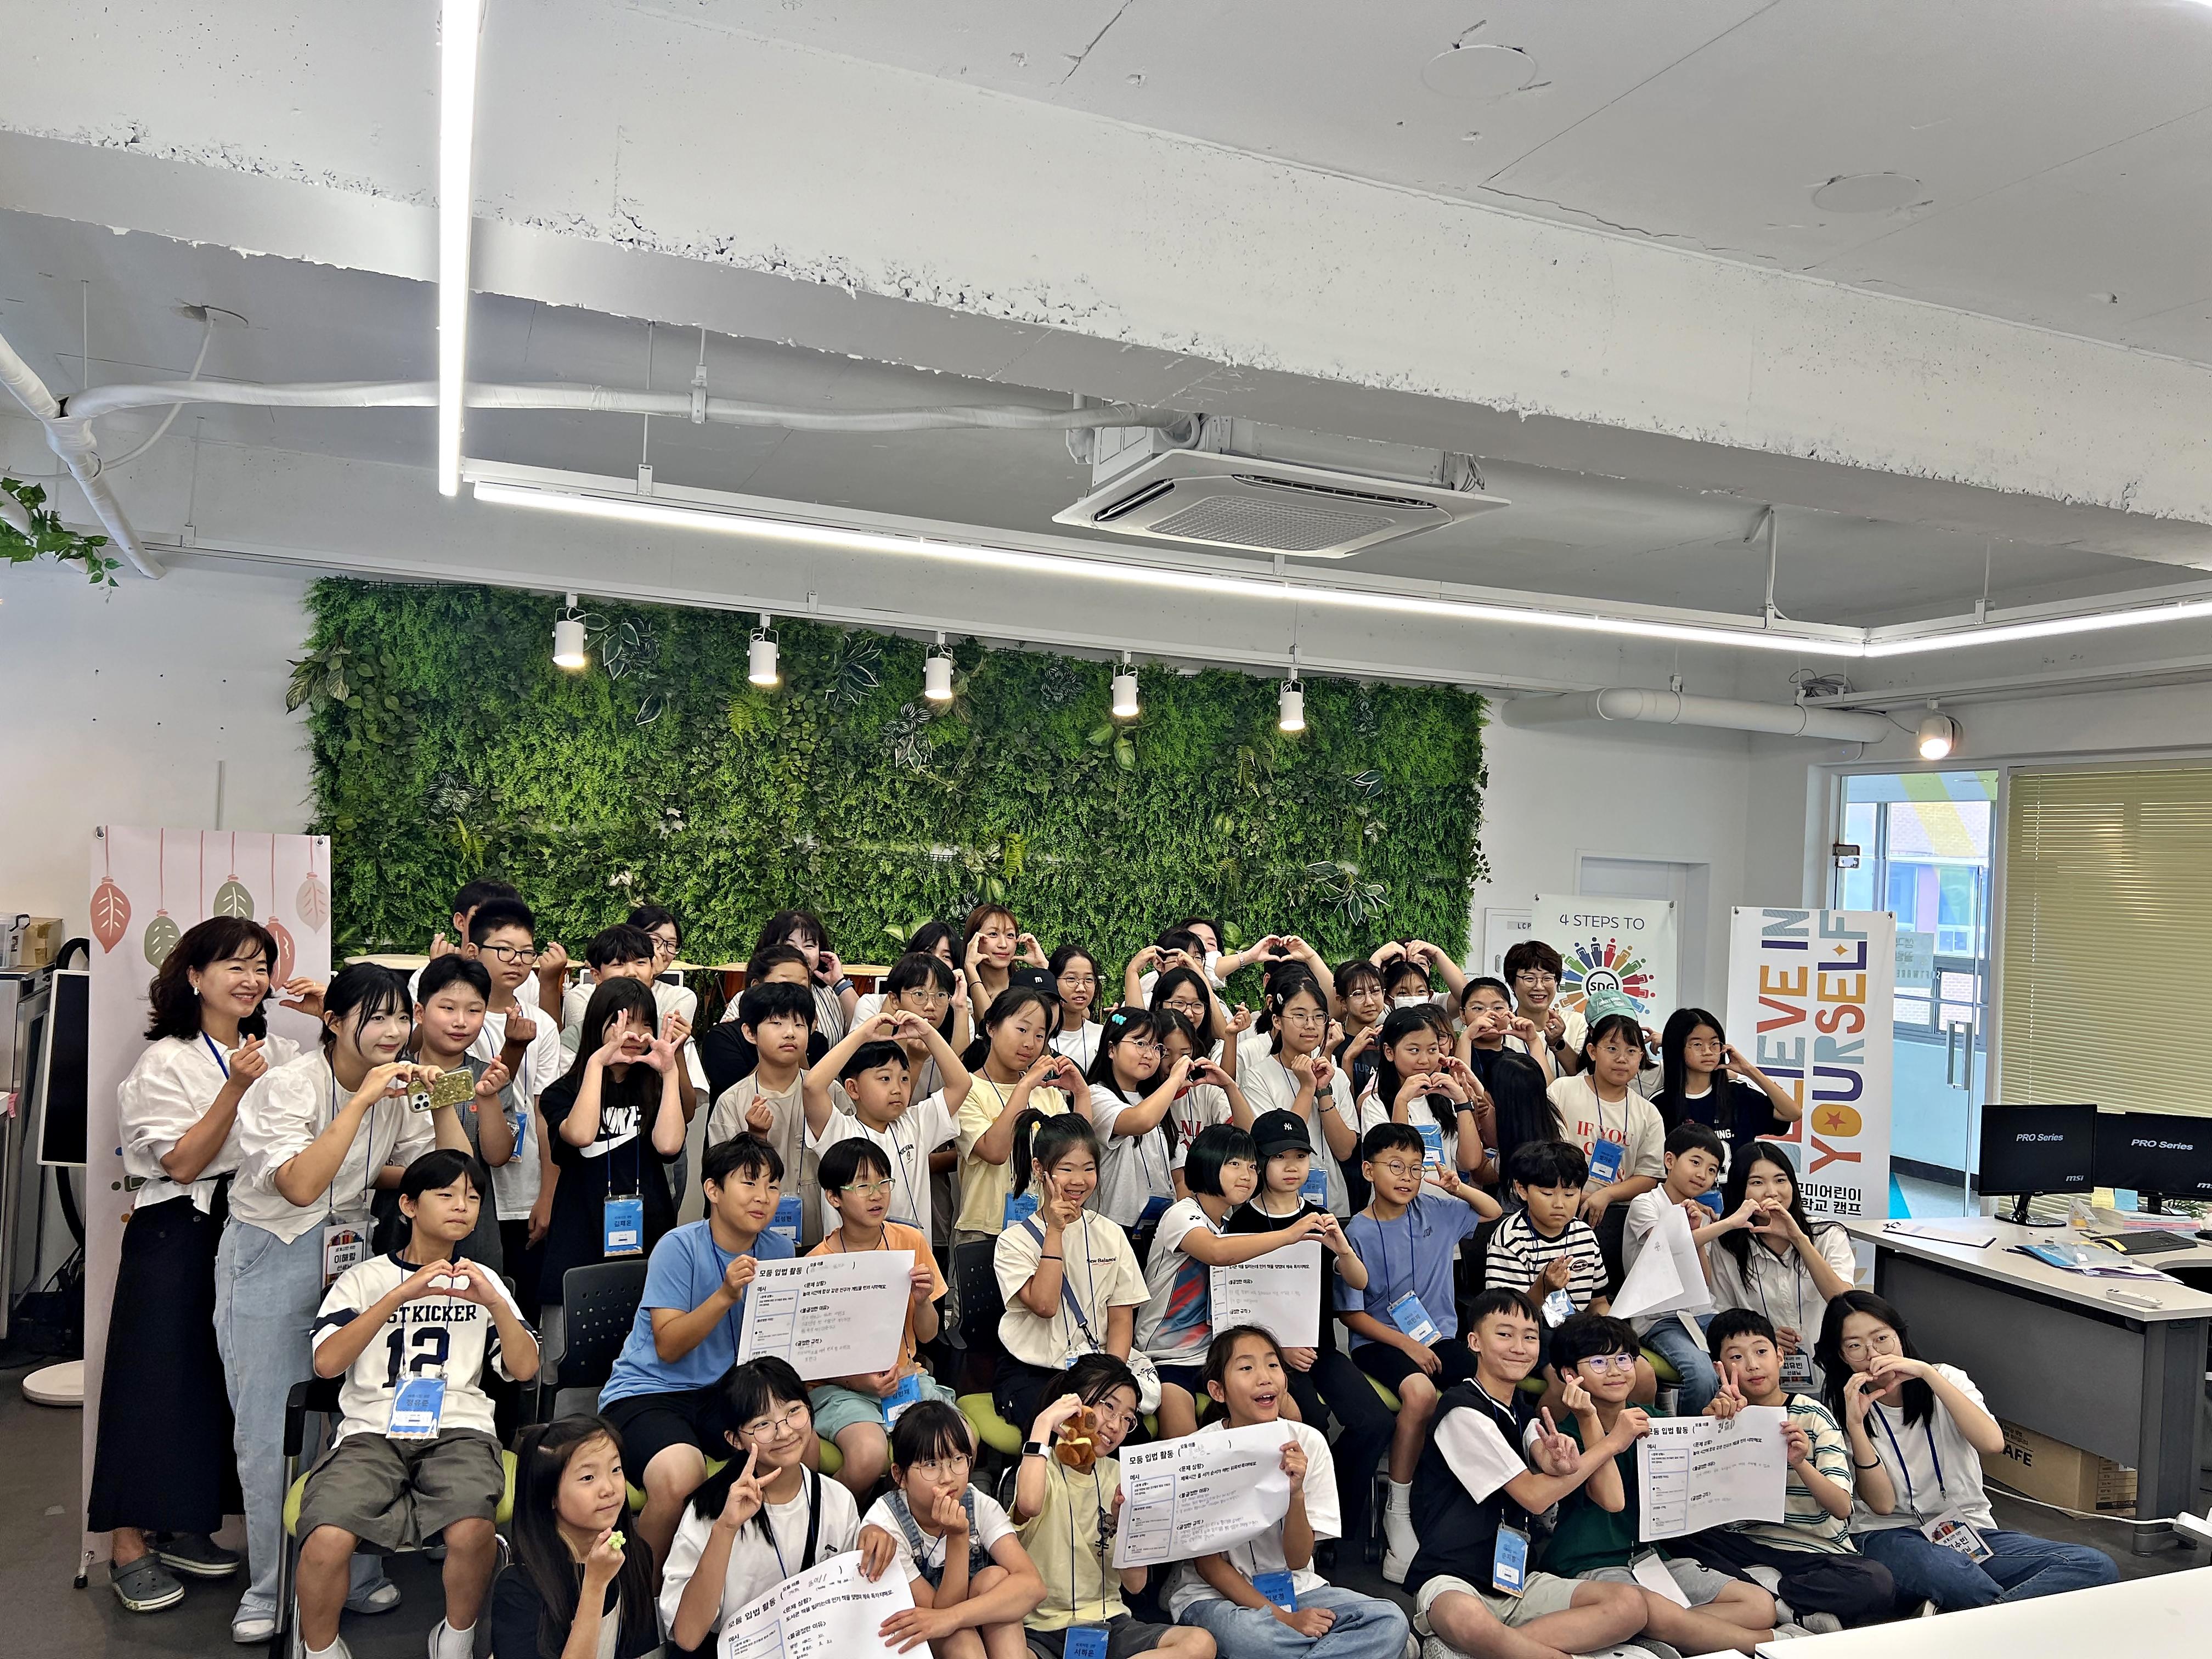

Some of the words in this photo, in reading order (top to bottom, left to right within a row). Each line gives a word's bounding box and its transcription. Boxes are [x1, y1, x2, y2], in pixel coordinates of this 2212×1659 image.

[1560, 914, 1569, 926] 4
[1573, 915, 1619, 929] STEPS
[1624, 917, 1645, 930] TO
[1762, 909, 1809, 950] IN
[1809, 910, 1868, 1175] YOURSELF
[1577, 1121, 1594, 1137] IF
[1599, 1125, 1634, 1147] YOU
[2016, 1133, 2036, 1142] PRO
[2037, 1133, 2063, 1141] Series
[2131, 1139, 2157, 1148] PRO
[2158, 1141, 2193, 1150] Series
[1833, 1200, 1861, 1216] 캠프
[775, 1268, 787, 1276] 입법
[789, 1267, 802, 1275] 활동
[411, 1305, 477, 1323] KICKER
[382, 1327, 450, 1388] 12
[1129, 1455, 1143, 1465] 모둠
[1145, 1453, 1158, 1463] 입법
[1160, 1450, 1174, 1460] 활동
[727, 1616, 743, 1629] 모둠
[744, 1607, 760, 1621] 입법
[762, 1597, 776, 1612] 활동
[729, 1634, 740, 1643] 예시
